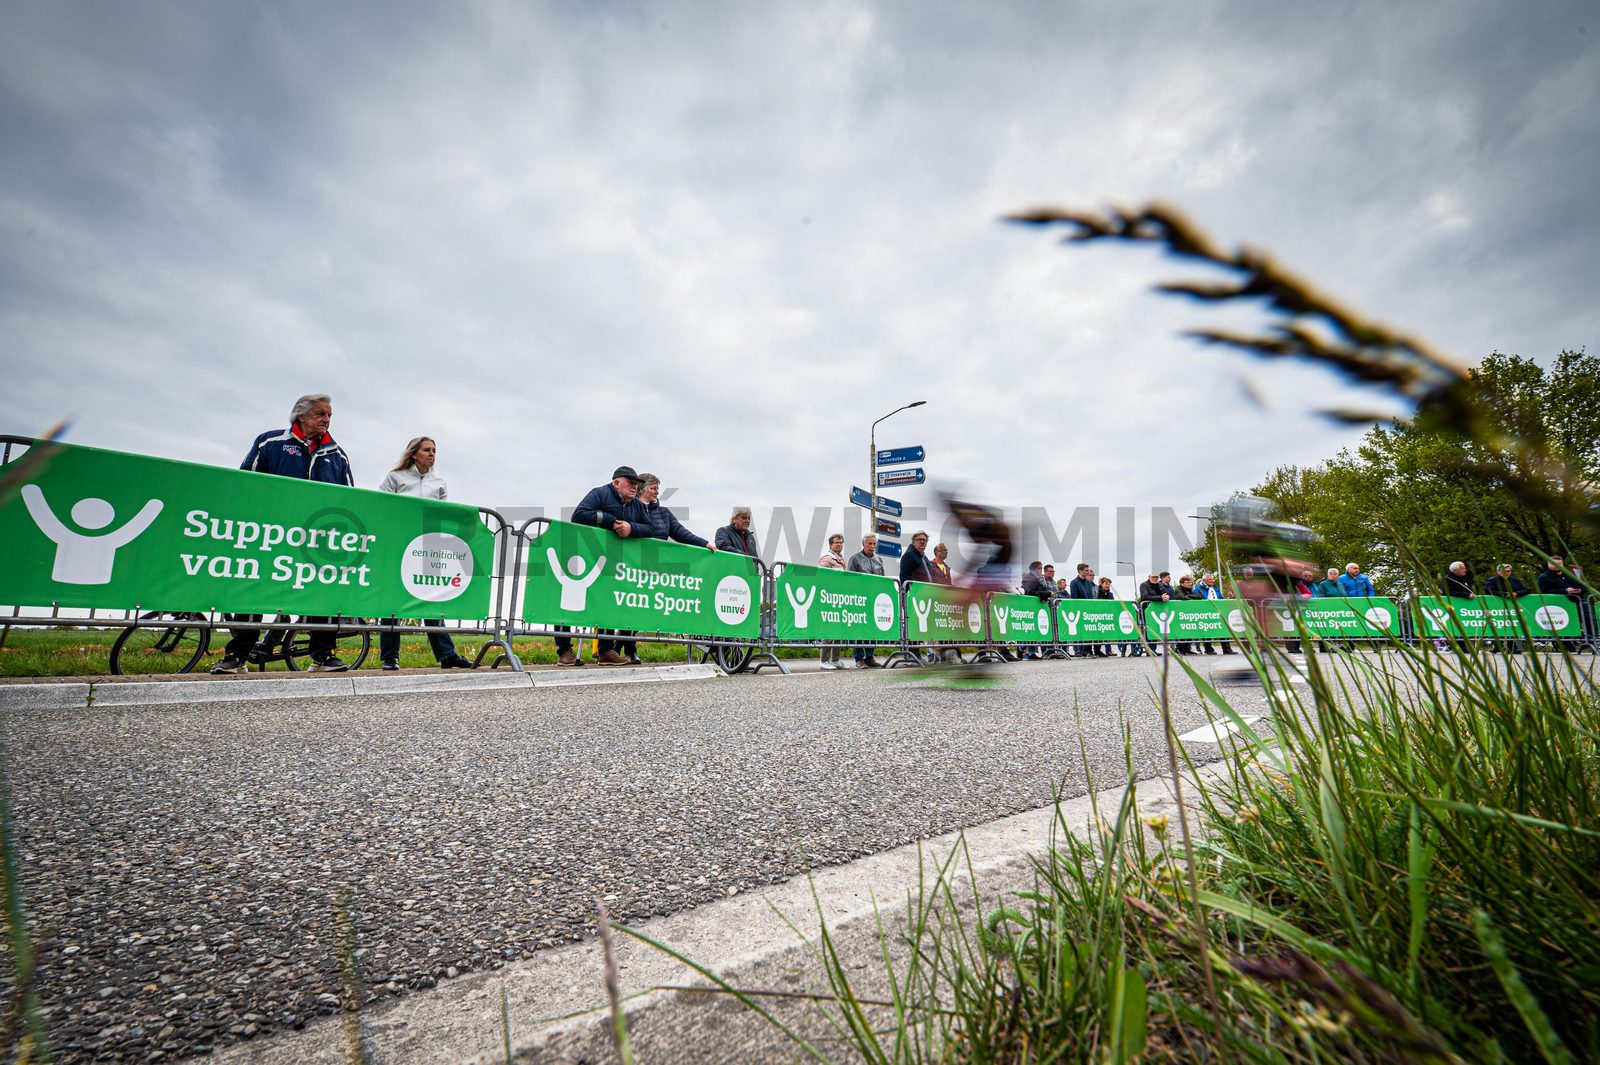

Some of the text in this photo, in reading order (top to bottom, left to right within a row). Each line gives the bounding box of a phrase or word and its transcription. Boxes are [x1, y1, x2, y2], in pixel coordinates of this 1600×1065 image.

[183, 509, 376, 553] Supporter
[411, 549, 467, 560] een initiatief
[430, 561, 447, 569] van
[180, 553, 371, 589] van Sport
[614, 562, 702, 591] Supporter
[412, 572, 462, 587] univé
[613, 590, 701, 615] van Sport
[820, 589, 867, 608] Supporter
[720, 604, 745, 614] univé
[934, 601, 964, 615] Supporter
[821, 609, 867, 626] van Sport
[1010, 608, 1034, 620] Supporter
[1083, 612, 1114, 622] Supporter
[1179, 611, 1220, 621] Supporter
[1305, 609, 1355, 619] Supporter
[935, 618, 947, 628] van
[948, 617, 964, 630] Sport
[1012, 622, 1021, 630] van
[1021, 621, 1035, 632] Sport
[1097, 623, 1115, 632] Sport
[1198, 622, 1222, 631] Sport
[1329, 620, 1357, 629] Sport
[1491, 618, 1520, 628] Spor
